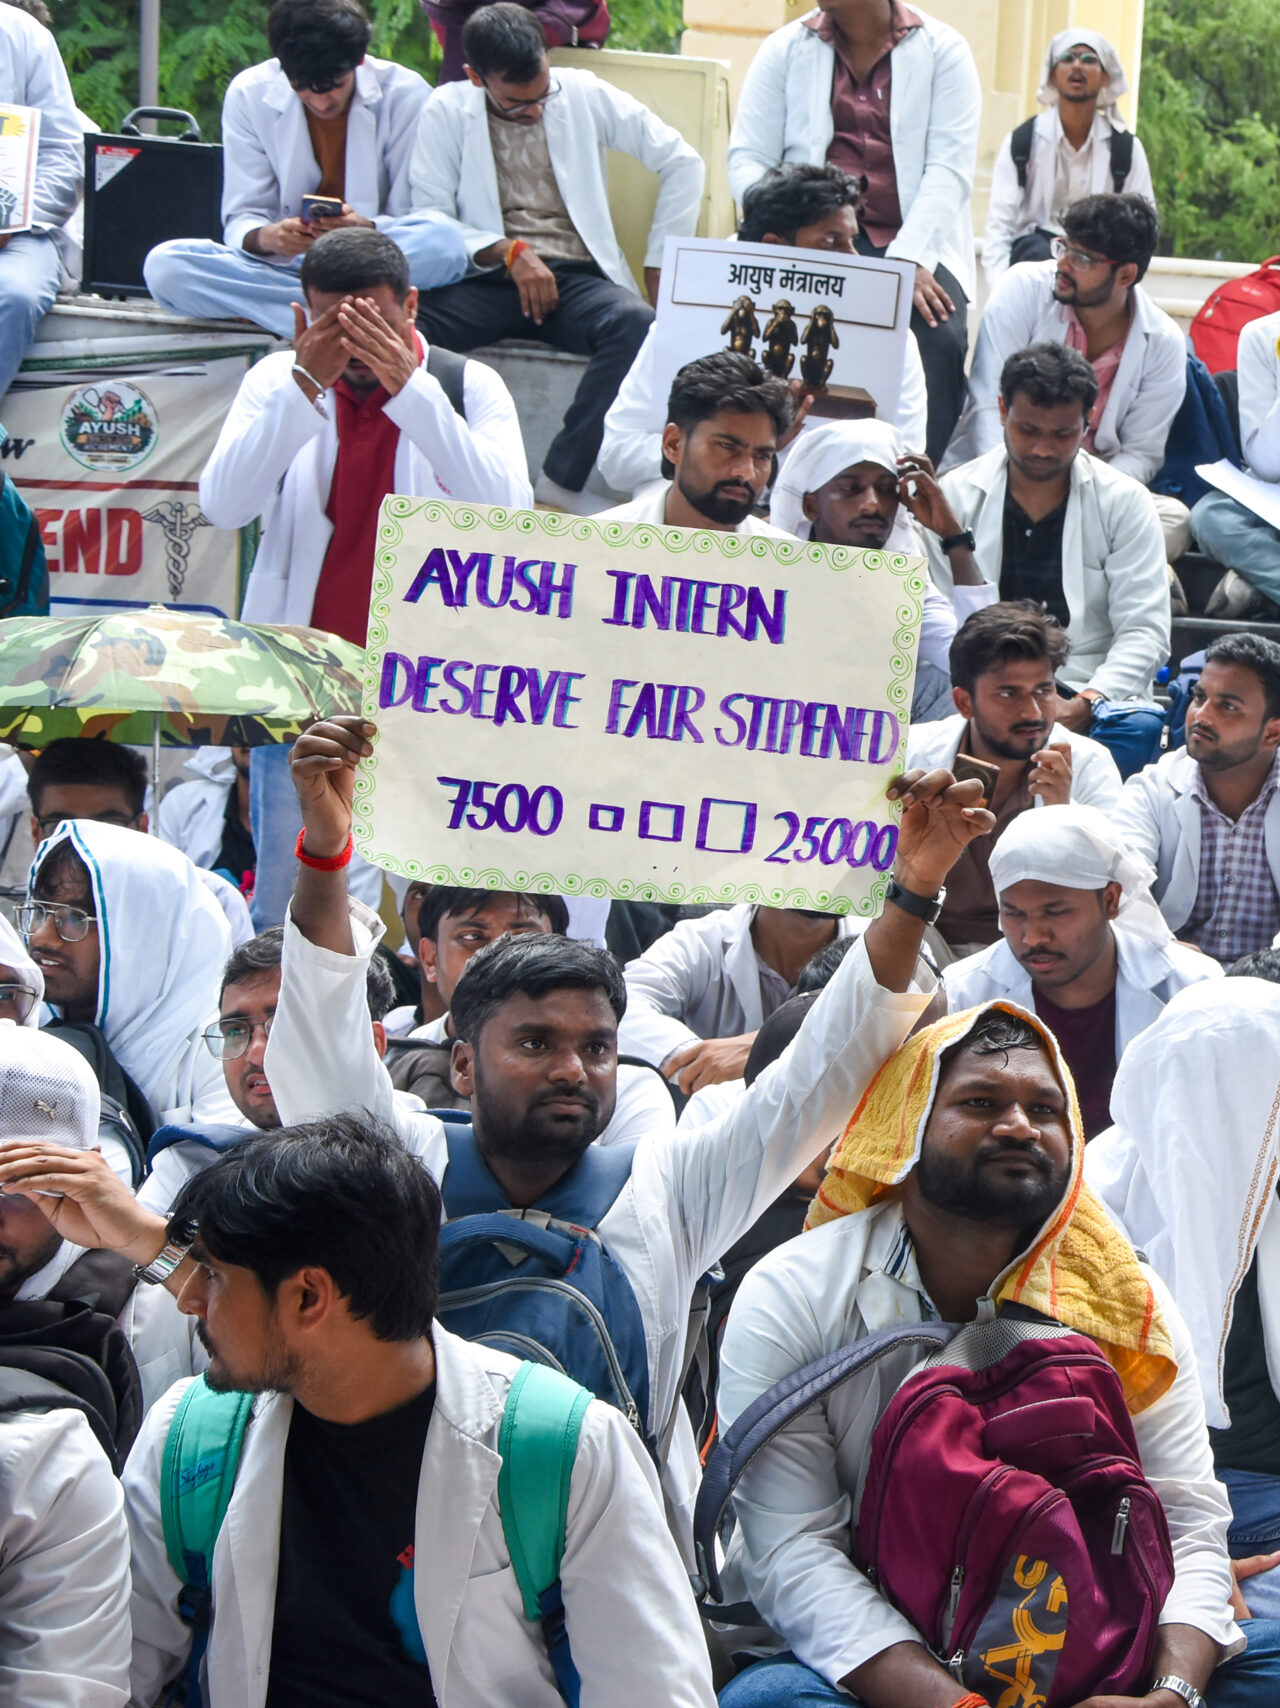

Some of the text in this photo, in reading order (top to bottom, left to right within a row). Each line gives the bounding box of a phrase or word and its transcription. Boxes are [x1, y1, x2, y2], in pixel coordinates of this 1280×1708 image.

[728, 264, 846, 298] आयुष मंत्रालय
[78, 421, 141, 436] AYUSH
[403, 548, 789, 645] AYUSH INTERN
[378, 651, 901, 766] DESERVE FAIR STIPENED
[436, 776, 900, 872] 7500 25000
